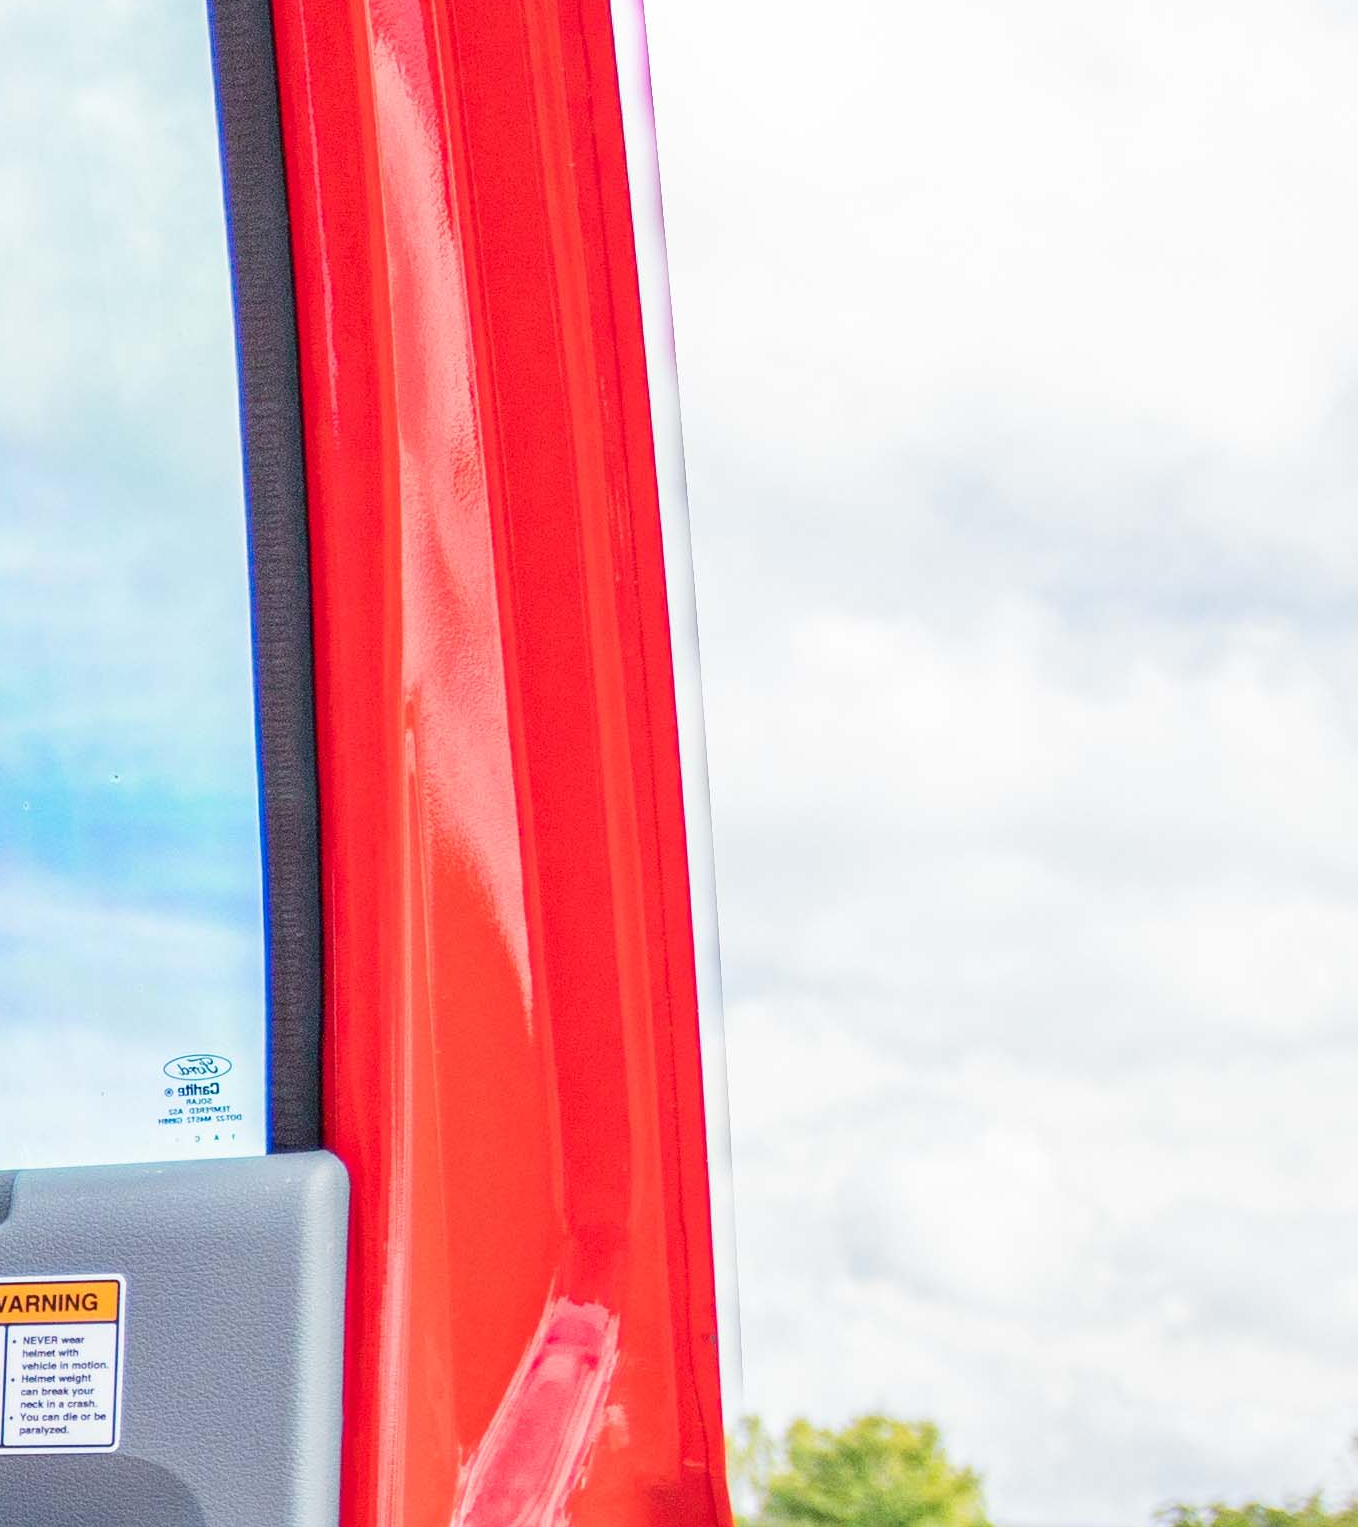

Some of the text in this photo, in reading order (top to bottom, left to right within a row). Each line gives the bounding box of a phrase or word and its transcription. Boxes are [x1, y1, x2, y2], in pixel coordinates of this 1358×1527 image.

[23, 1336, 85, 1344] NEVER wear
[23, 1348, 79, 1357] helmet with
[22, 1361, 109, 1370] vehicle in motion.
[21, 1374, 91, 1384] Helmet weight
[21, 1386, 95, 1397] can break your
[20, 1400, 43, 1409] neck
[46, 1400, 55, 1408] in
[68, 1399, 97, 1408] crash.
[20, 1412, 39, 1422] You
[63, 1412, 77, 1421] die
[94, 1412, 106, 1421] be
[19, 1426, 69, 1436] paralyzed.
